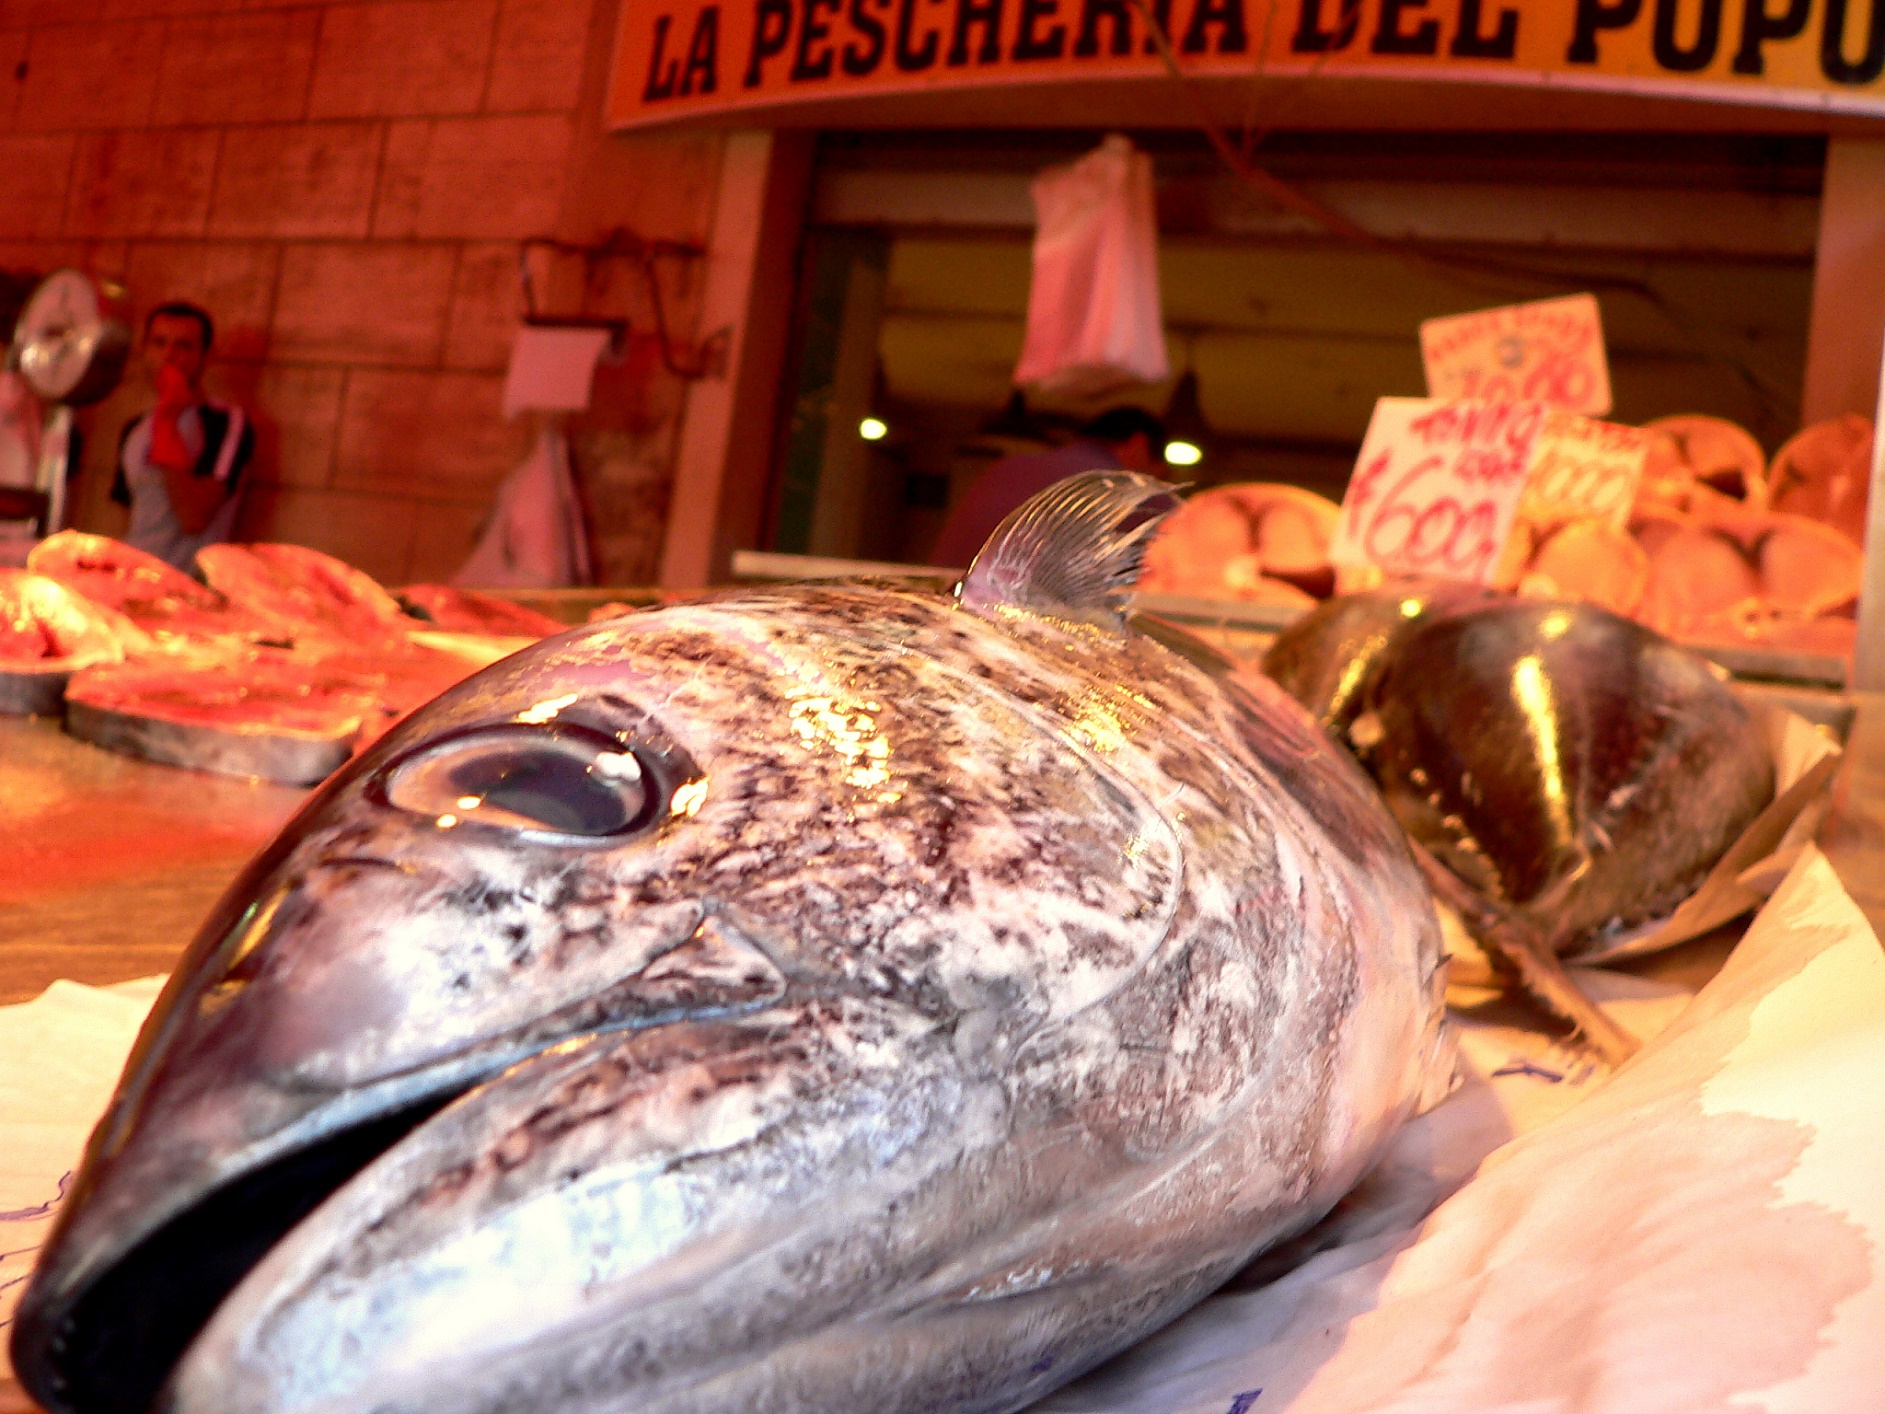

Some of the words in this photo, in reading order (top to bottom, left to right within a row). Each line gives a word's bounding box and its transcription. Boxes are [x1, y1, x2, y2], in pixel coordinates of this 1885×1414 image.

[641, 10, 718, 102] LA
[742, 0, 1248, 88] PESCHERIA
[1291, 0, 1519, 58] DEL
